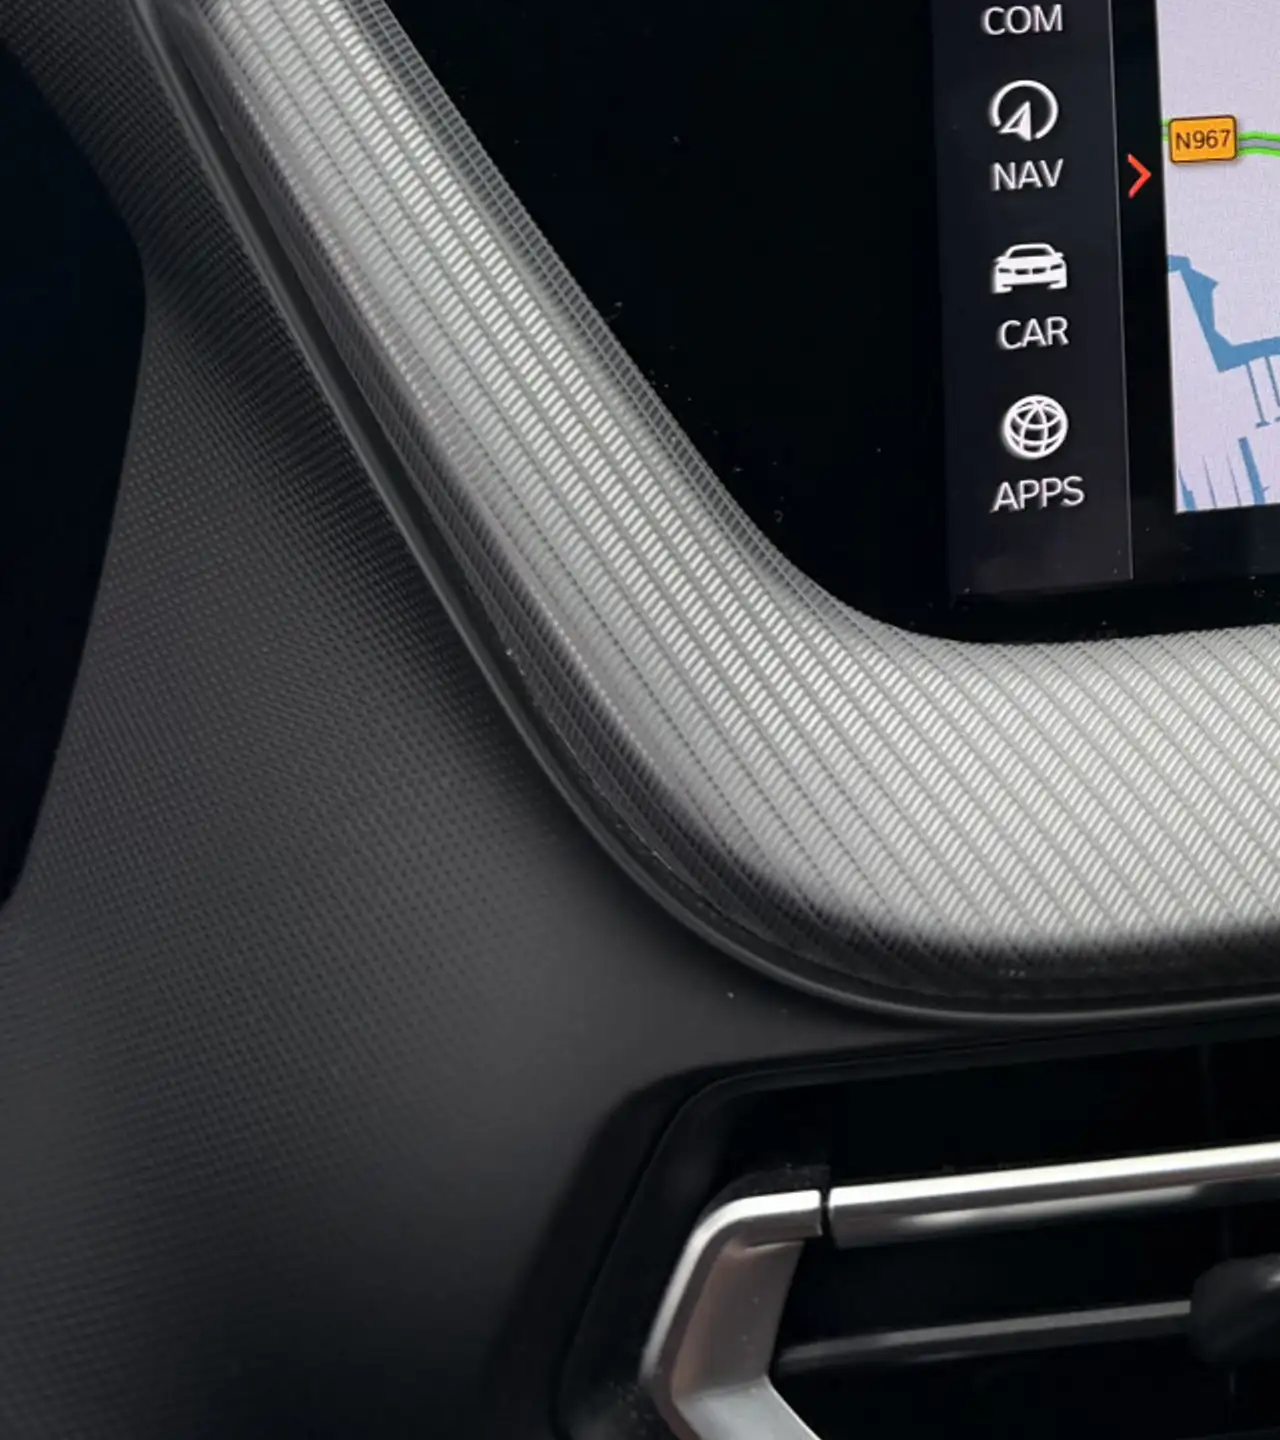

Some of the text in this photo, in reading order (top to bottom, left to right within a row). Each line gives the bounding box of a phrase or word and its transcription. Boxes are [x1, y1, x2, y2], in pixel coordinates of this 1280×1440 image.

[981, 4, 1063, 36] COM
[1174, 129, 1231, 152] N967
[991, 158, 1064, 192] NAV
[998, 316, 1069, 349] CAR
[990, 475, 1086, 512] APPS
